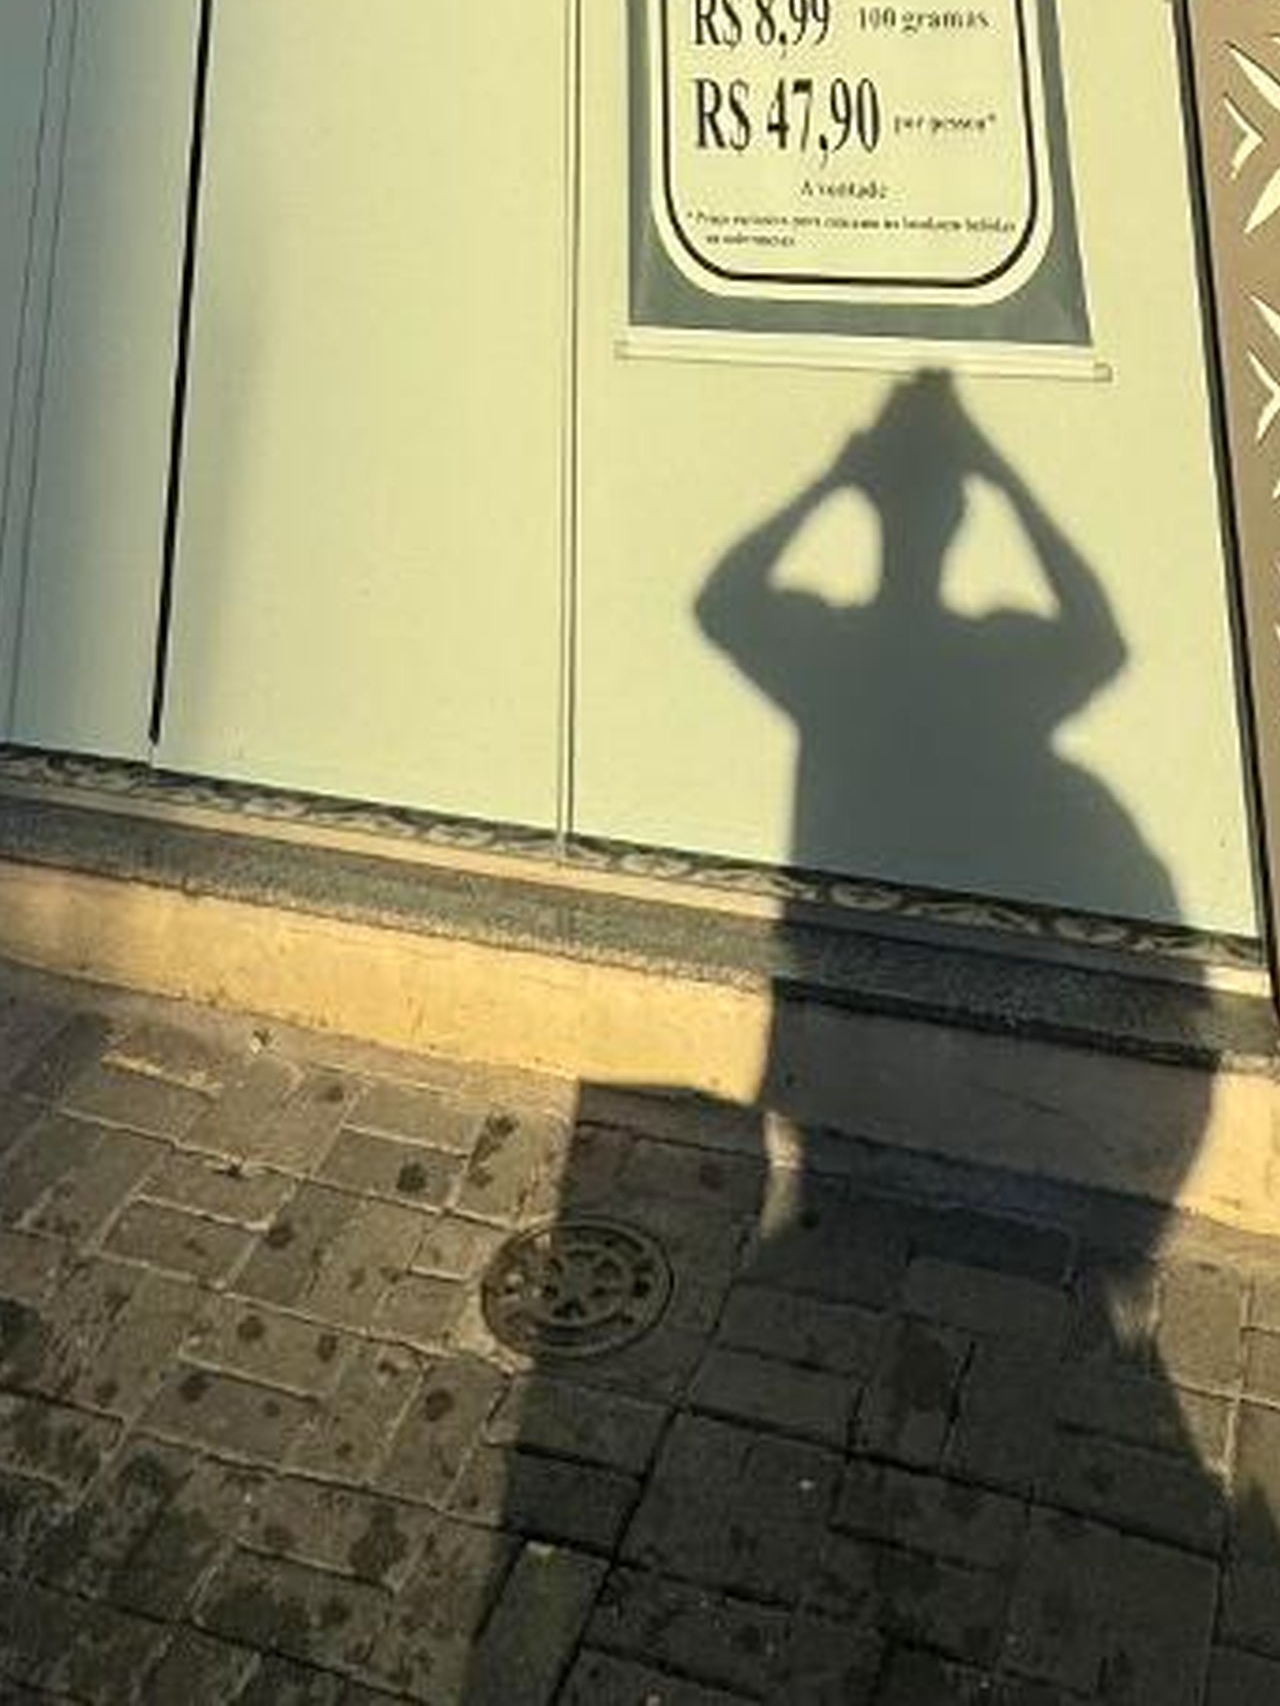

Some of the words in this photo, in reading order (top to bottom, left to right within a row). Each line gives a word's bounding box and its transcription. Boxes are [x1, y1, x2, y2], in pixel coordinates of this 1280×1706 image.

[858, 7, 897, 31] 100
[901, 8, 991, 34] gramas
[693, 77, 752, 153] R$
[766, 76, 882, 170] 47,90
